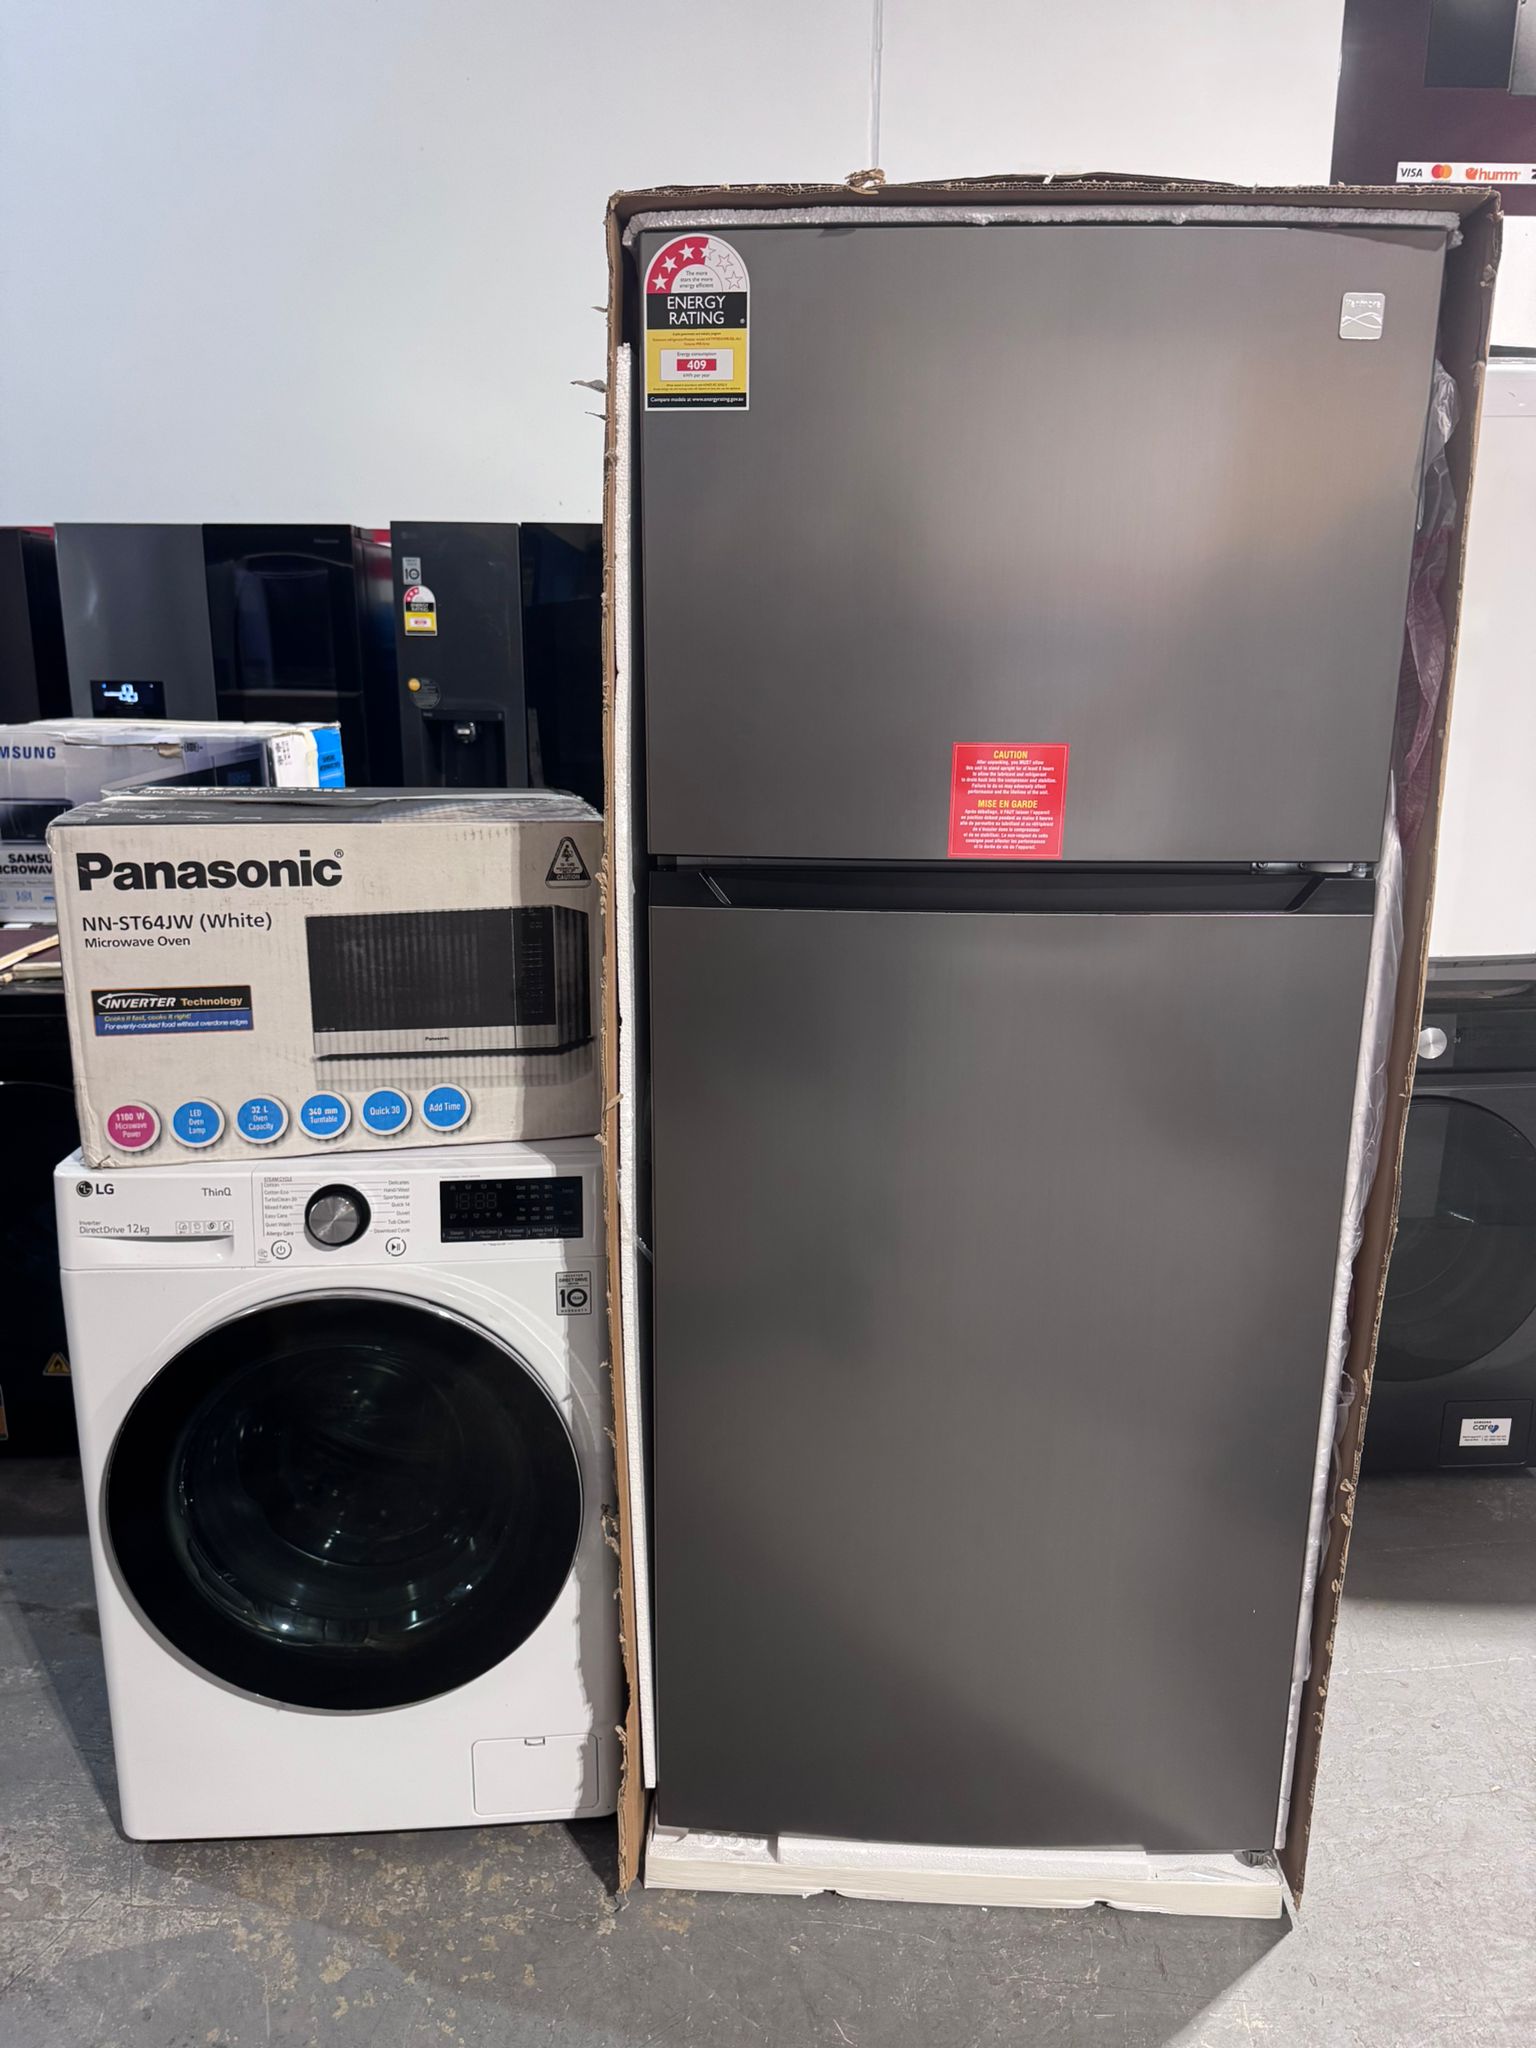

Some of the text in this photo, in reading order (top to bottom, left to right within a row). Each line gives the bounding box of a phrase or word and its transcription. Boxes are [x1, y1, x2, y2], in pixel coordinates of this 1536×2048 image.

[1400, 168, 1423, 178] VISA
[1478, 169, 1519, 180] humm
[667, 296, 726, 310] ENERGY
[669, 311, 725, 325] RATING
[687, 360, 707, 370] 409
[993, 750, 1028, 759] CAUTION
[977, 800, 1038, 809] MISE EN GARDE
[82, 911, 273, 933] NN-ST64JW (White)
[85, 936, 191, 949] Microwave Oven
[104, 996, 243, 1009] INVERTER Technology
[117, 1022, 160, 1030] evenly-cooked
[263, 1105, 269, 1113] L
[369, 1106, 401, 1115] Quick 30
[429, 1103, 461, 1112] Add Time
[137, 1112, 145, 1120] W
[189, 1109, 202, 1117] LED
[189, 1118, 204, 1126] Oven
[310, 1115, 338, 1124] Turntable
[115, 1121, 147, 1130] Microwave
[248, 1122, 274, 1131] Capacity
[189, 1127, 206, 1135] Lamp
[96, 1184, 115, 1195] LG
[202, 1187, 232, 1197] ThinQ
[560, 1288, 588, 1308] 10
